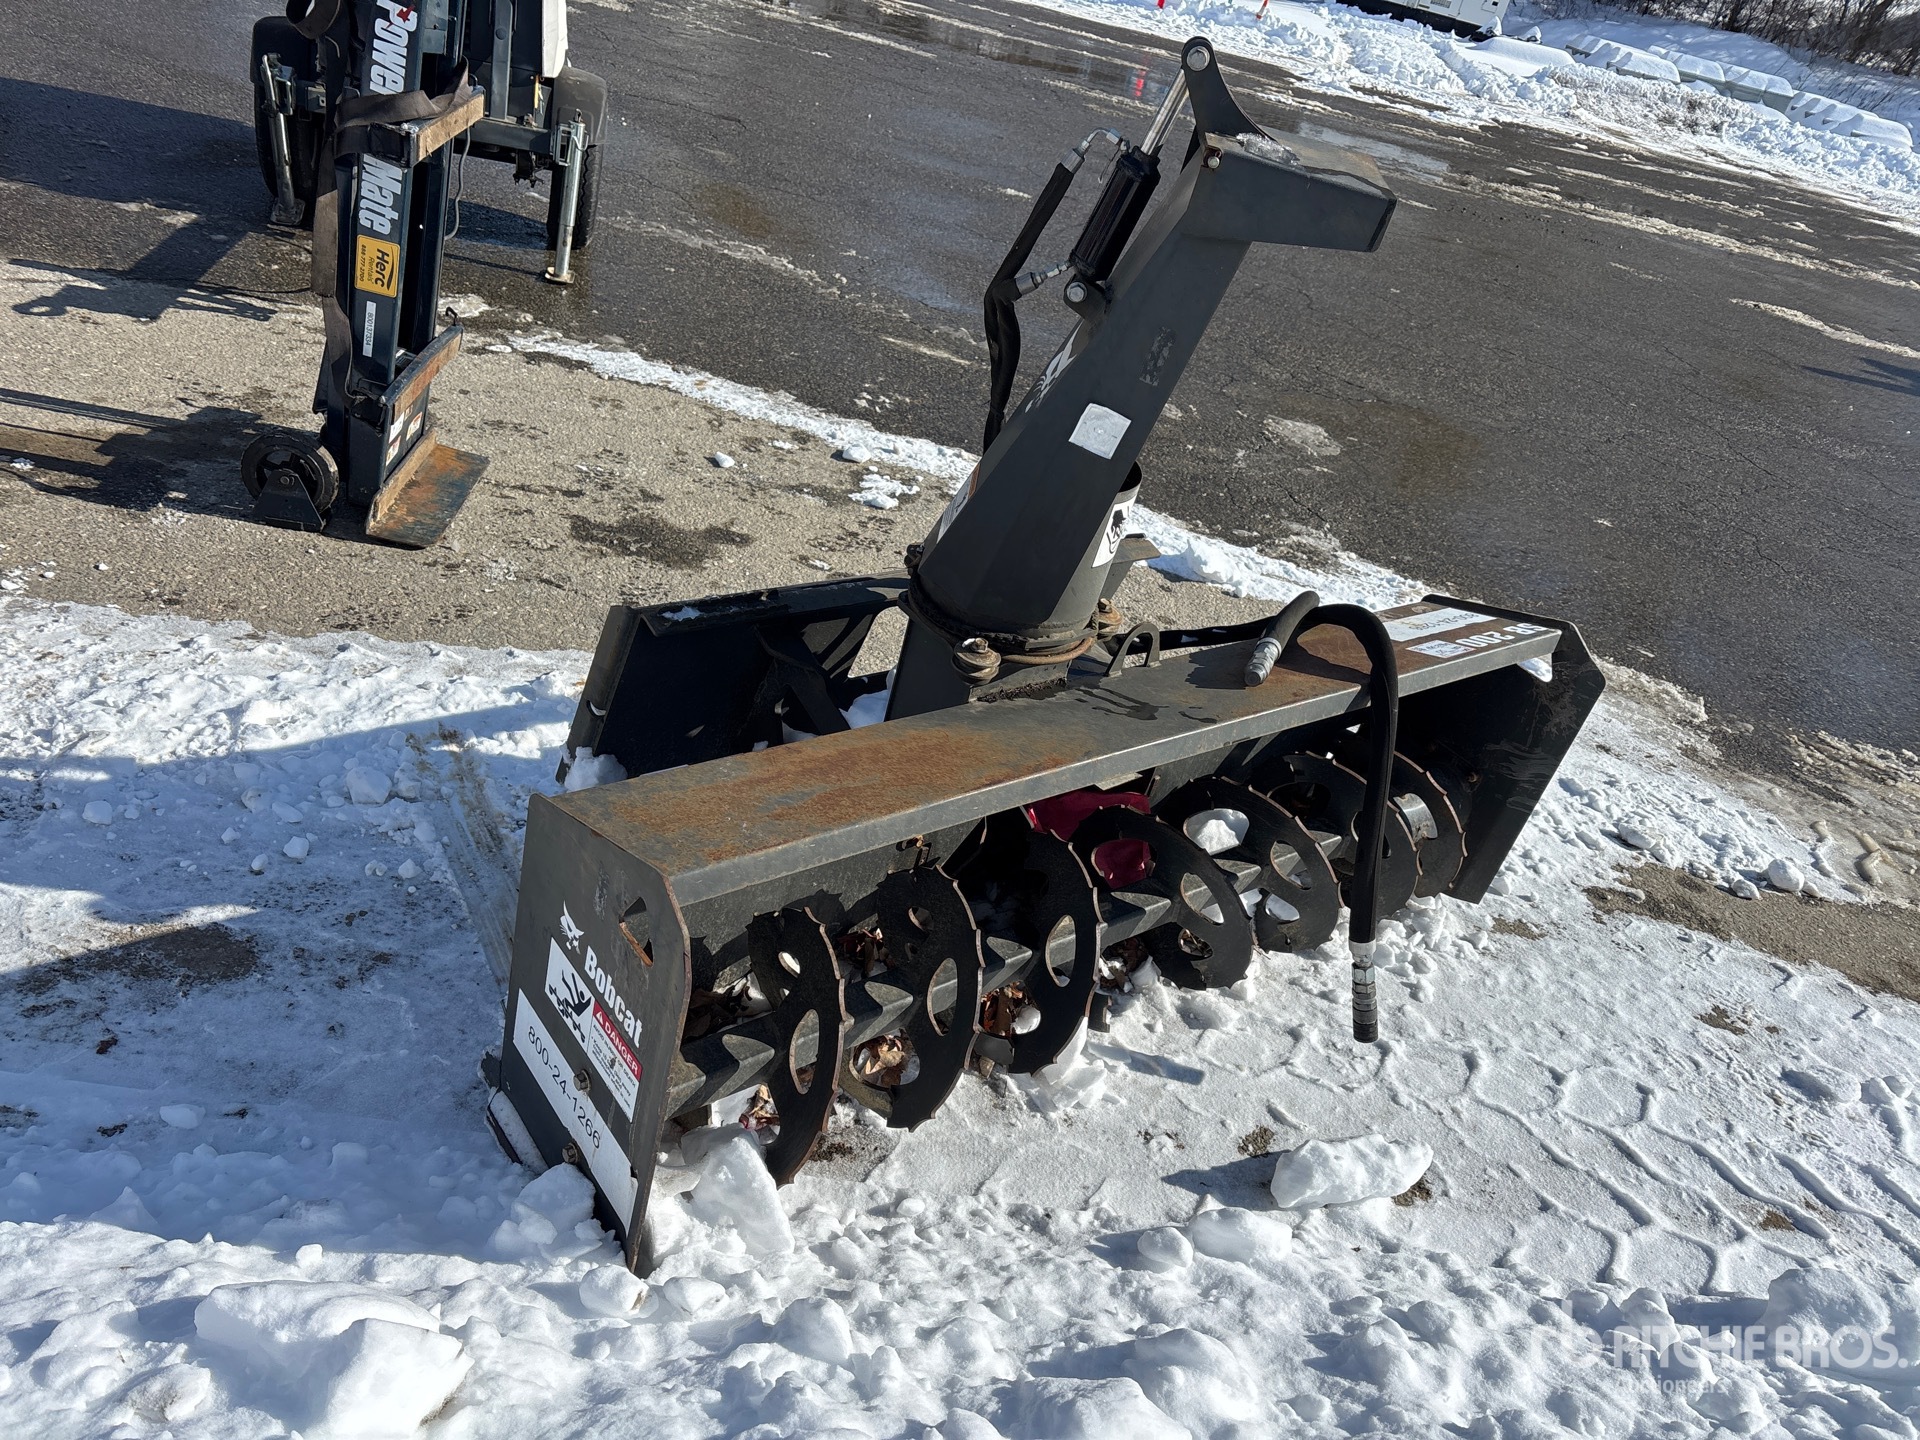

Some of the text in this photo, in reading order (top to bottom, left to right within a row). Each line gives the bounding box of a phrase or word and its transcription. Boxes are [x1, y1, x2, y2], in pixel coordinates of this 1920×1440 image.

[359, 153, 403, 235] Mate
[375, 248, 390, 288] Herc
[1455, 623, 1549, 647] SB 200
[584, 945, 643, 1048] Bobcat
[604, 1022, 638, 1076] DANGER
[528, 1025, 601, 1149] 800-24-1266
